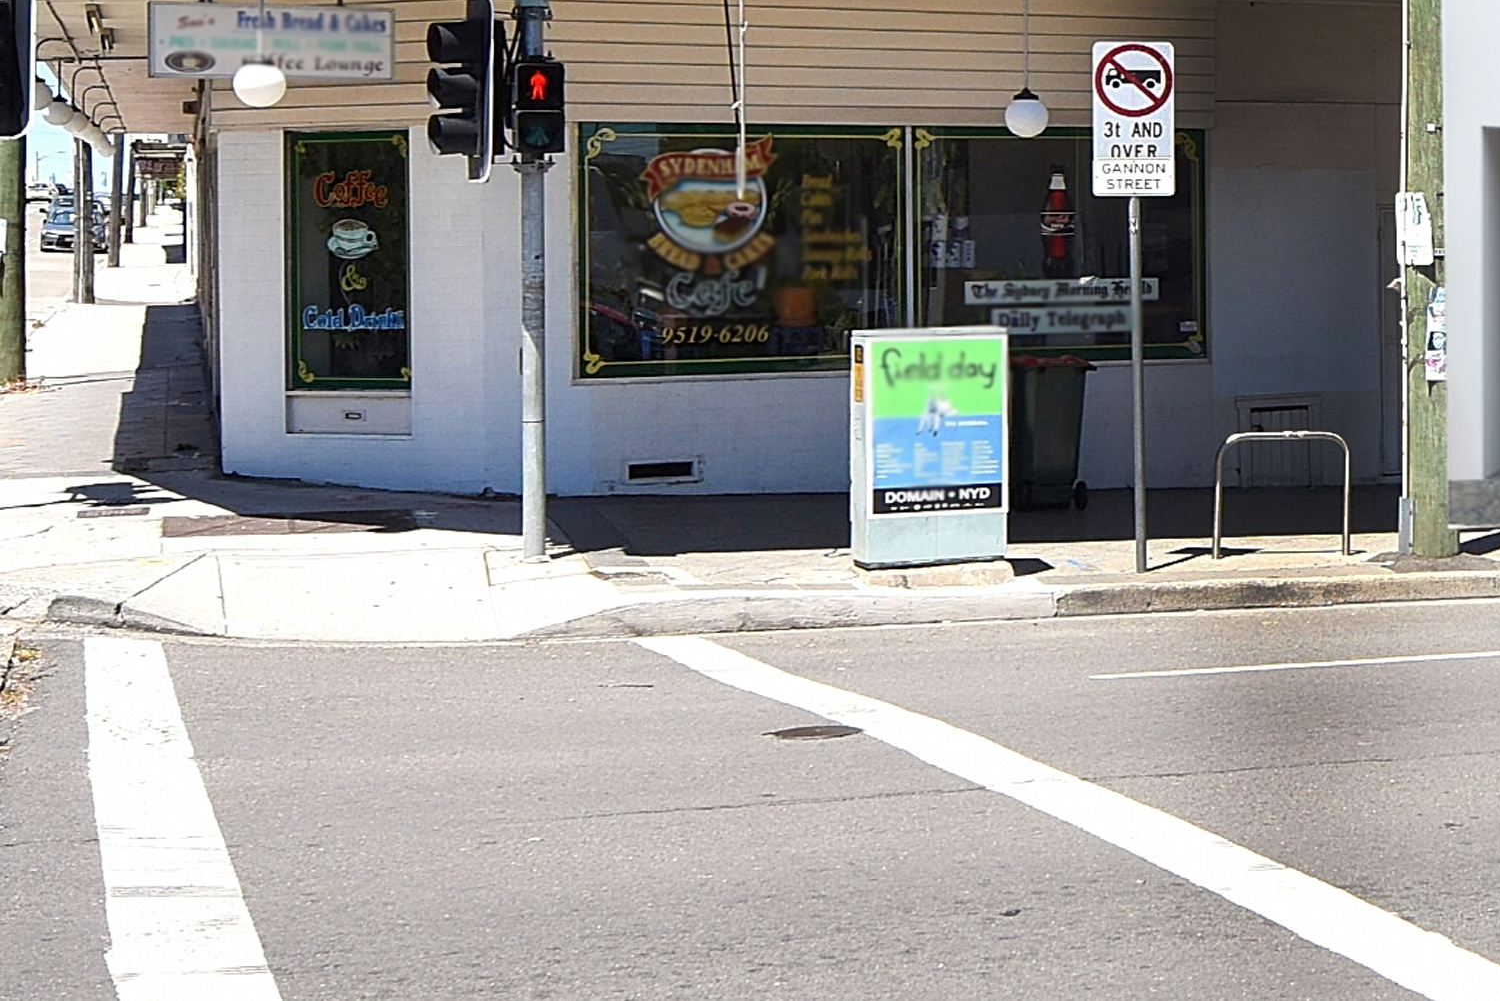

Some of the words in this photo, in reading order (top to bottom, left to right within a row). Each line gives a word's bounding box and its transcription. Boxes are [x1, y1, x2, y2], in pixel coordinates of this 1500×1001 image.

[345, 11, 387, 33] Cakes
[314, 55, 385, 77] Lounge
[1103, 121, 1121, 138] 3t
[1131, 121, 1163, 138] AND
[1110, 144, 1157, 158] OVER
[658, 155, 763, 178] SYDENHM
[1102, 163, 1166, 175] GANNON
[313, 170, 389, 208] Coffee
[1106, 179, 1161, 190] STREET
[341, 265, 367, 291] &
[971, 285, 997, 299] The
[1111, 280, 1152, 297] Held
[303, 305, 343, 330] Cold
[1000, 312, 1040, 331] Daily
[661, 324, 769, 345] 9519-6206
[885, 488, 945, 505] DOMAIN
[959, 486, 991, 501] NYD
